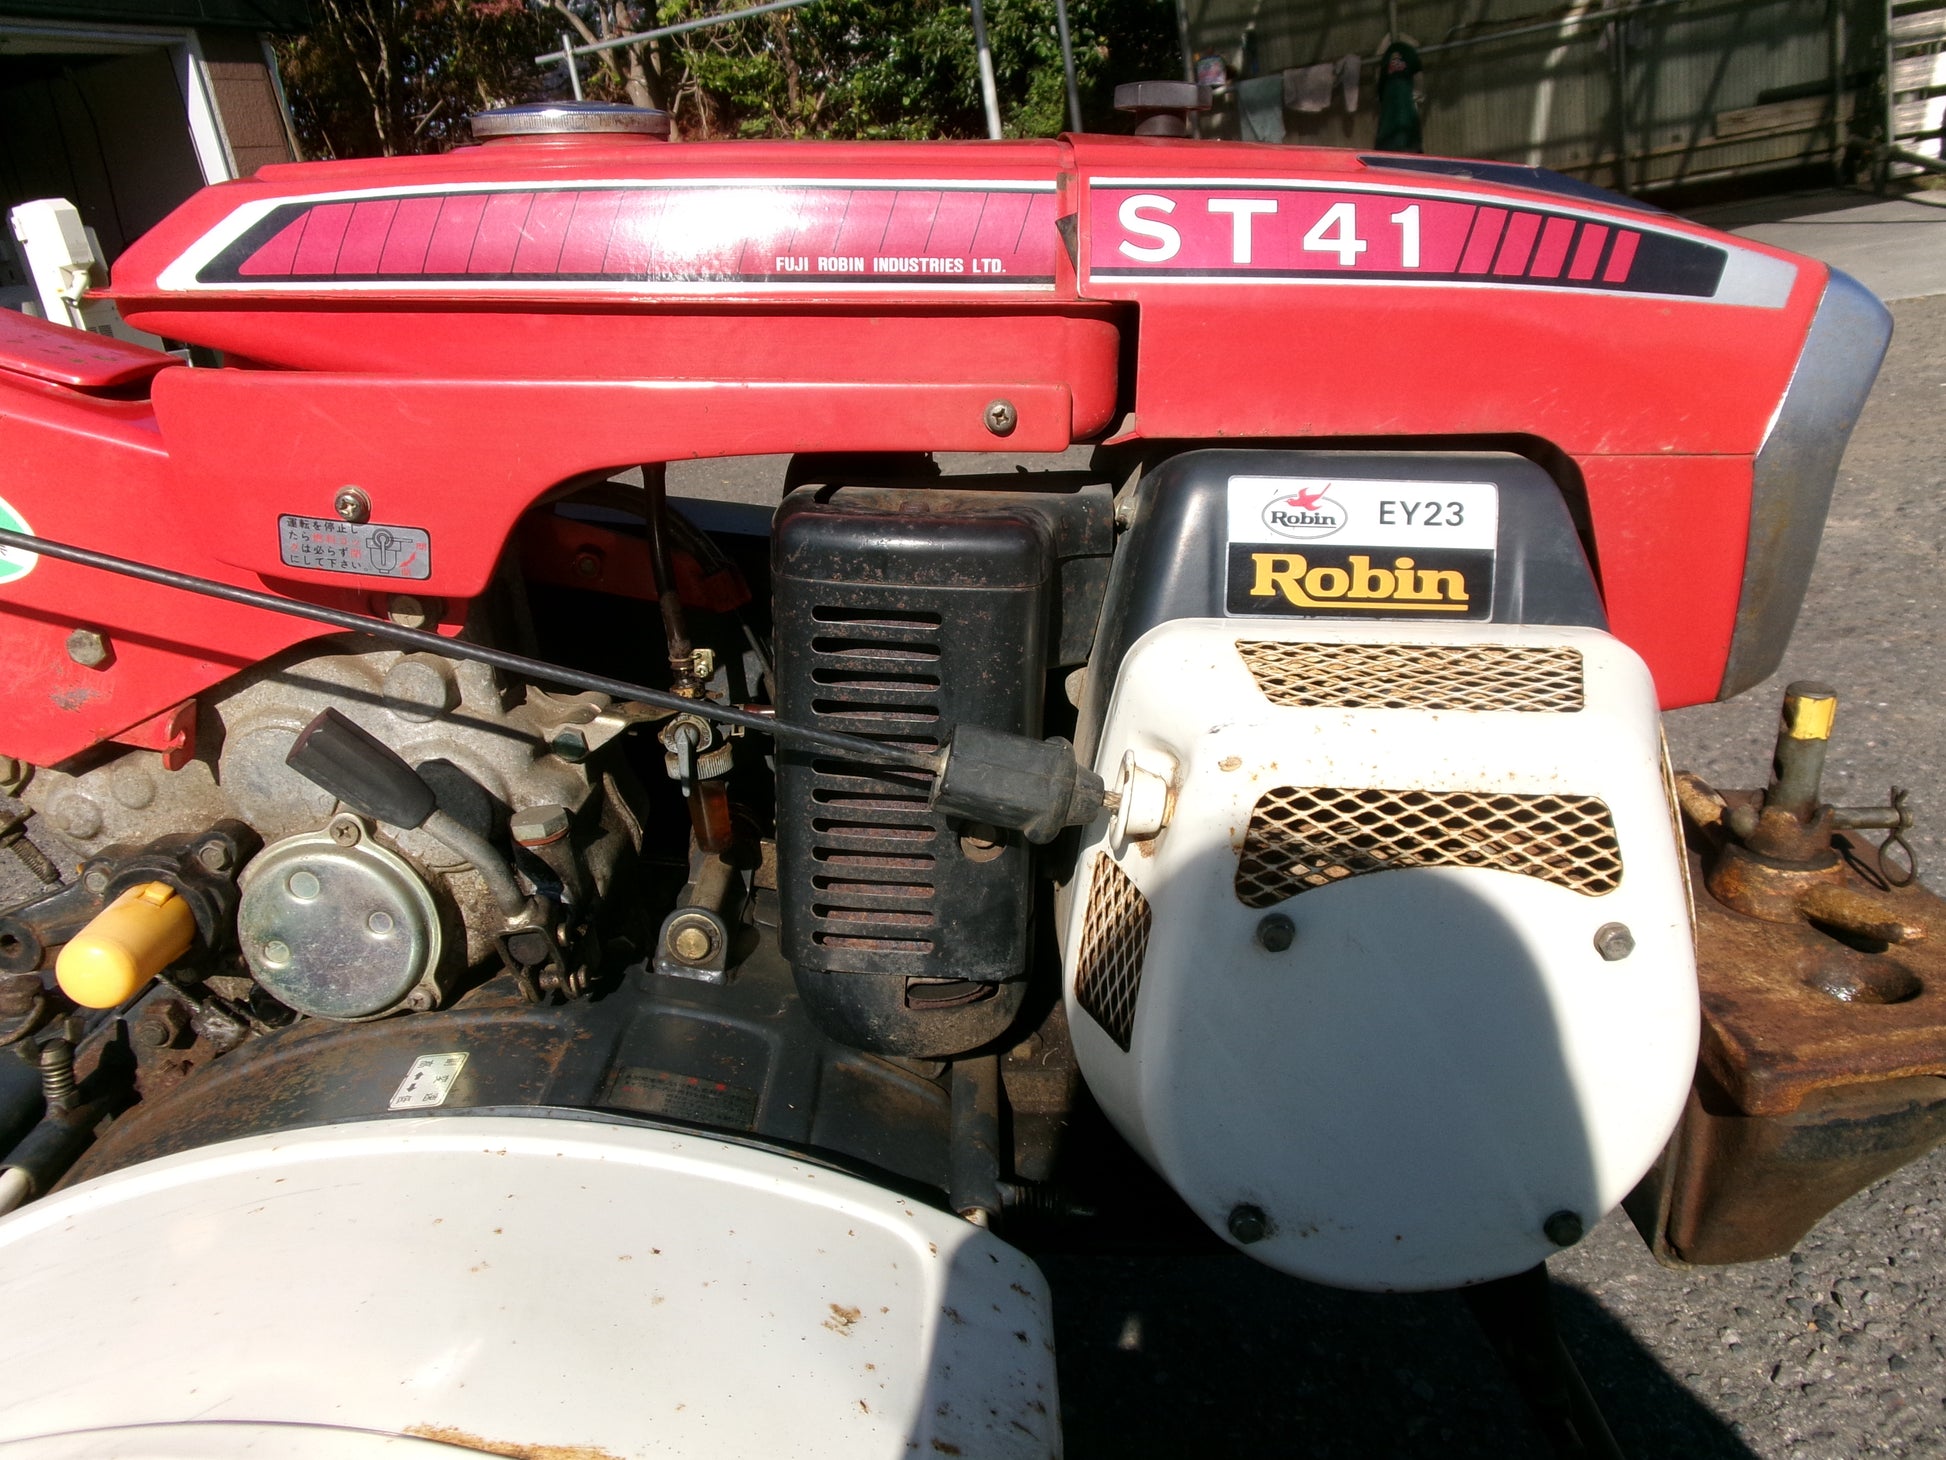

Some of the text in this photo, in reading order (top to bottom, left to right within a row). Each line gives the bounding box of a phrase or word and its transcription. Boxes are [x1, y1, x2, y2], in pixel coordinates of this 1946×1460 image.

[775, 256, 1007, 273] FUJI ROBIN INDUSTRIES LTD.
[1270, 510, 1337, 529] Robin
[1379, 500, 1465, 527] EY23
[1250, 553, 1470, 611] Robin
